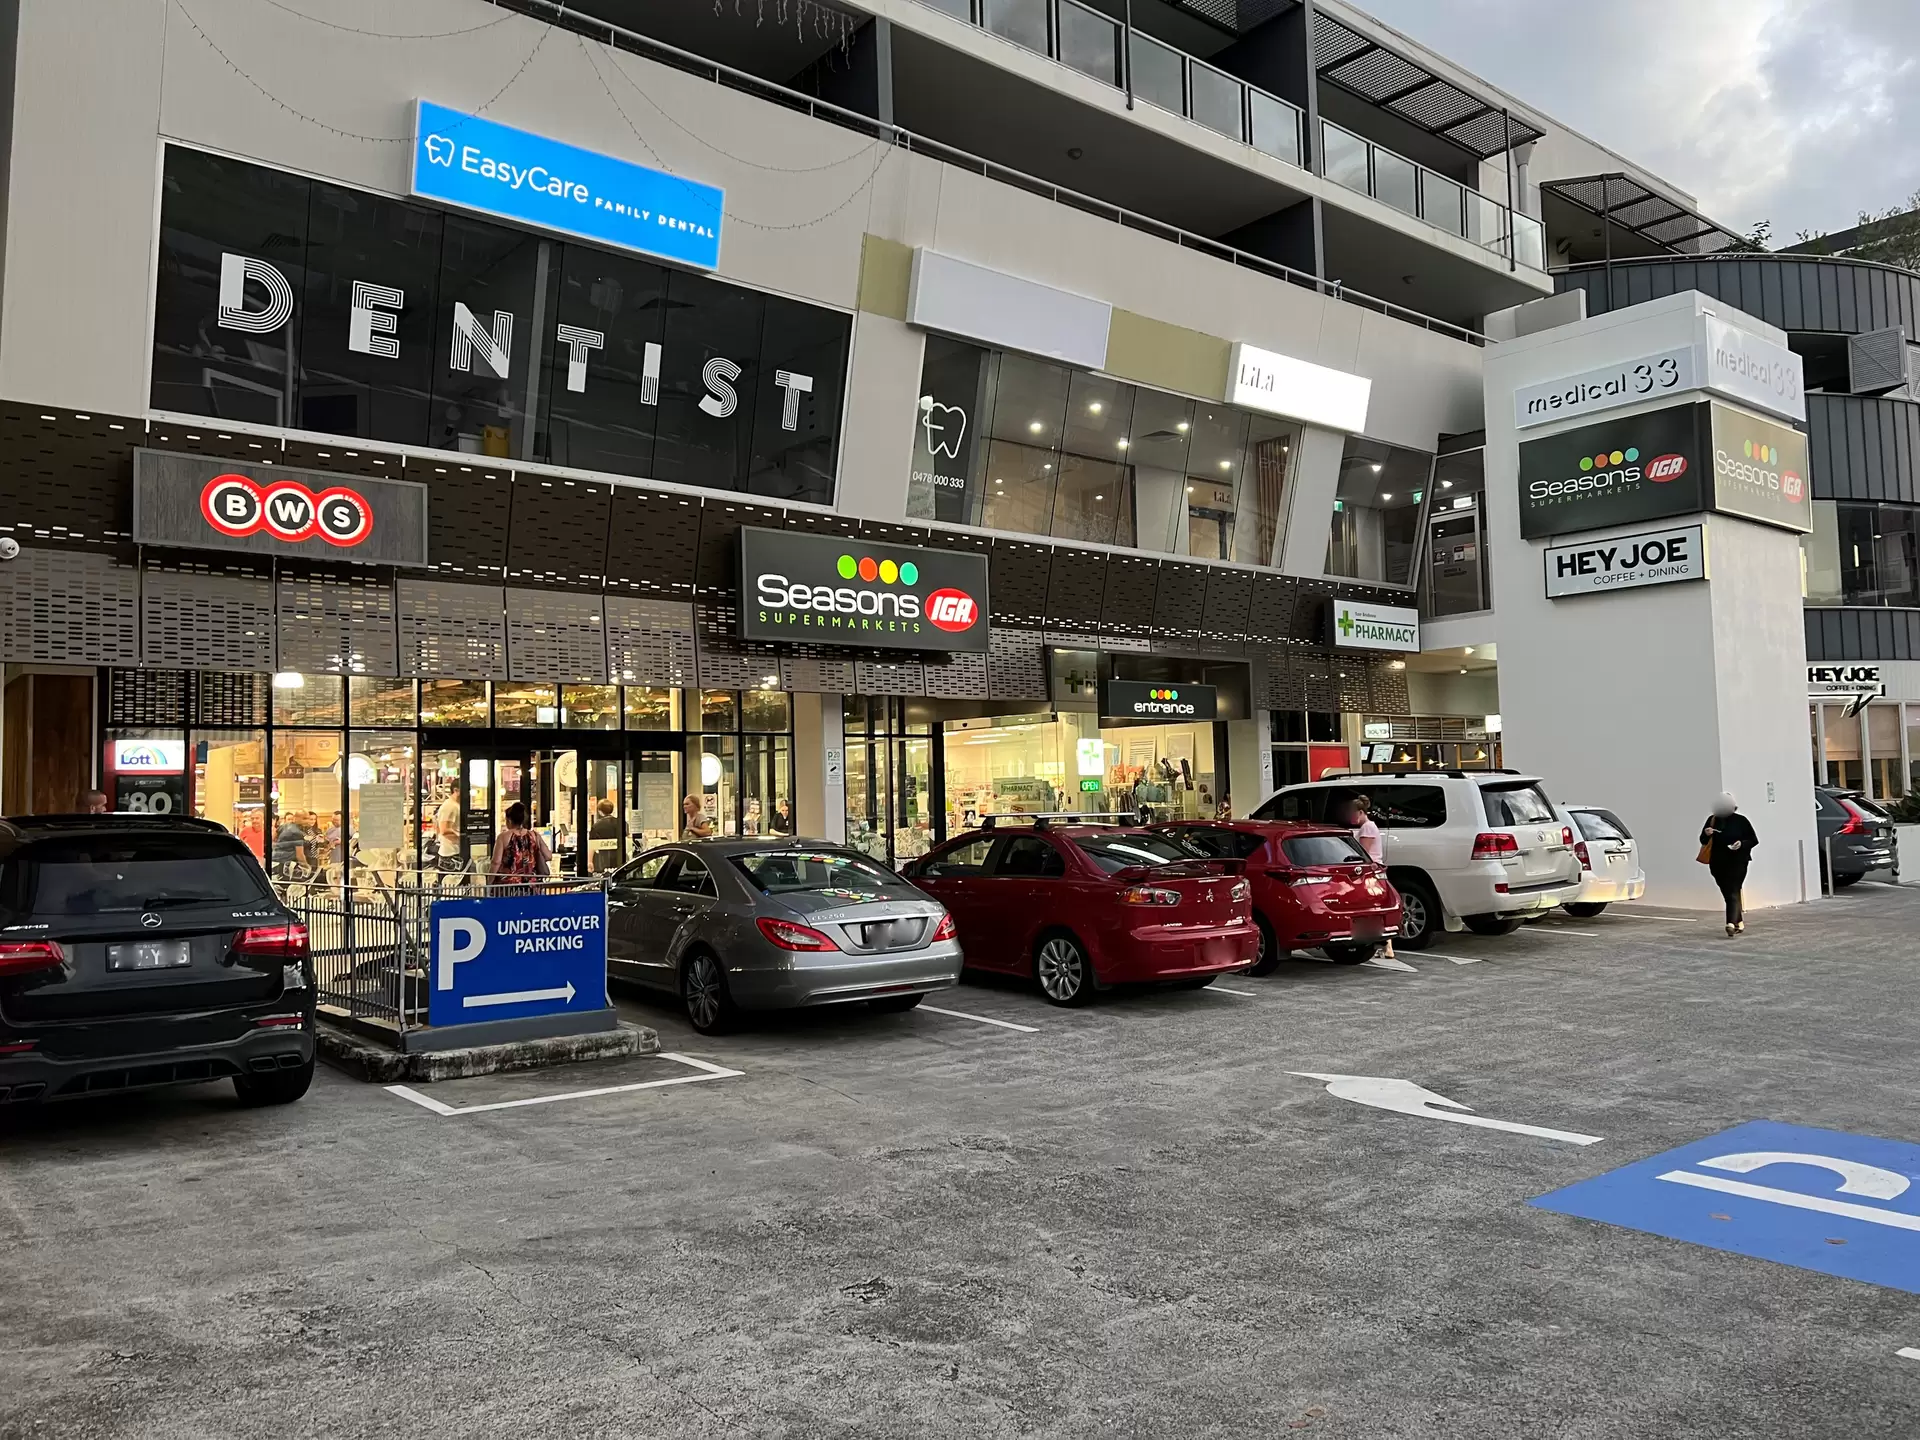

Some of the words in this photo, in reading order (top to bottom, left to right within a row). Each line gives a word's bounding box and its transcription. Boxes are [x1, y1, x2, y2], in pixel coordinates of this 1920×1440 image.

[461, 145, 589, 204] EasyCare
[595, 197, 650, 221] FAMILY
[658, 214, 715, 239] DENTAL
[218, 252, 813, 432] DENTIST
[1715, 346, 1772, 388] medical
[1773, 361, 1797, 401] 33
[1527, 372, 1626, 414] medical
[1632, 358, 1680, 393] 33
[1650, 457, 1684, 477] IGA
[1716, 449, 1779, 490] Seasons
[912, 471, 933, 483] 0478
[934, 475, 948, 486] 000
[950, 478, 965, 489] 333
[1529, 465, 1641, 500] Seasons
[1783, 475, 1802, 496] IGA
[1530, 483, 1642, 508] SUPERMARKETS
[1557, 547, 1617, 578] HEY
[1620, 537, 1688, 568] JOE
[1593, 571, 1636, 585] COFFEE
[1649, 564, 1689, 578] DINING
[757, 573, 920, 618] Seasons
[759, 611, 920, 633] SUPERMARKETS
[1355, 624, 1416, 643] PHARMACY
[1807, 667, 1844, 682] HEY
[1844, 667, 1880, 682] JOE
[1133, 701, 1195, 714] entrance
[121, 754, 151, 765] Lott
[1002, 784, 1034, 793] PHARMACY
[1082, 781, 1099, 791] OPEN
[497, 915, 600, 936] UNDERCOVER
[437, 917, 487, 991] P
[515, 935, 584, 954] PARKING
